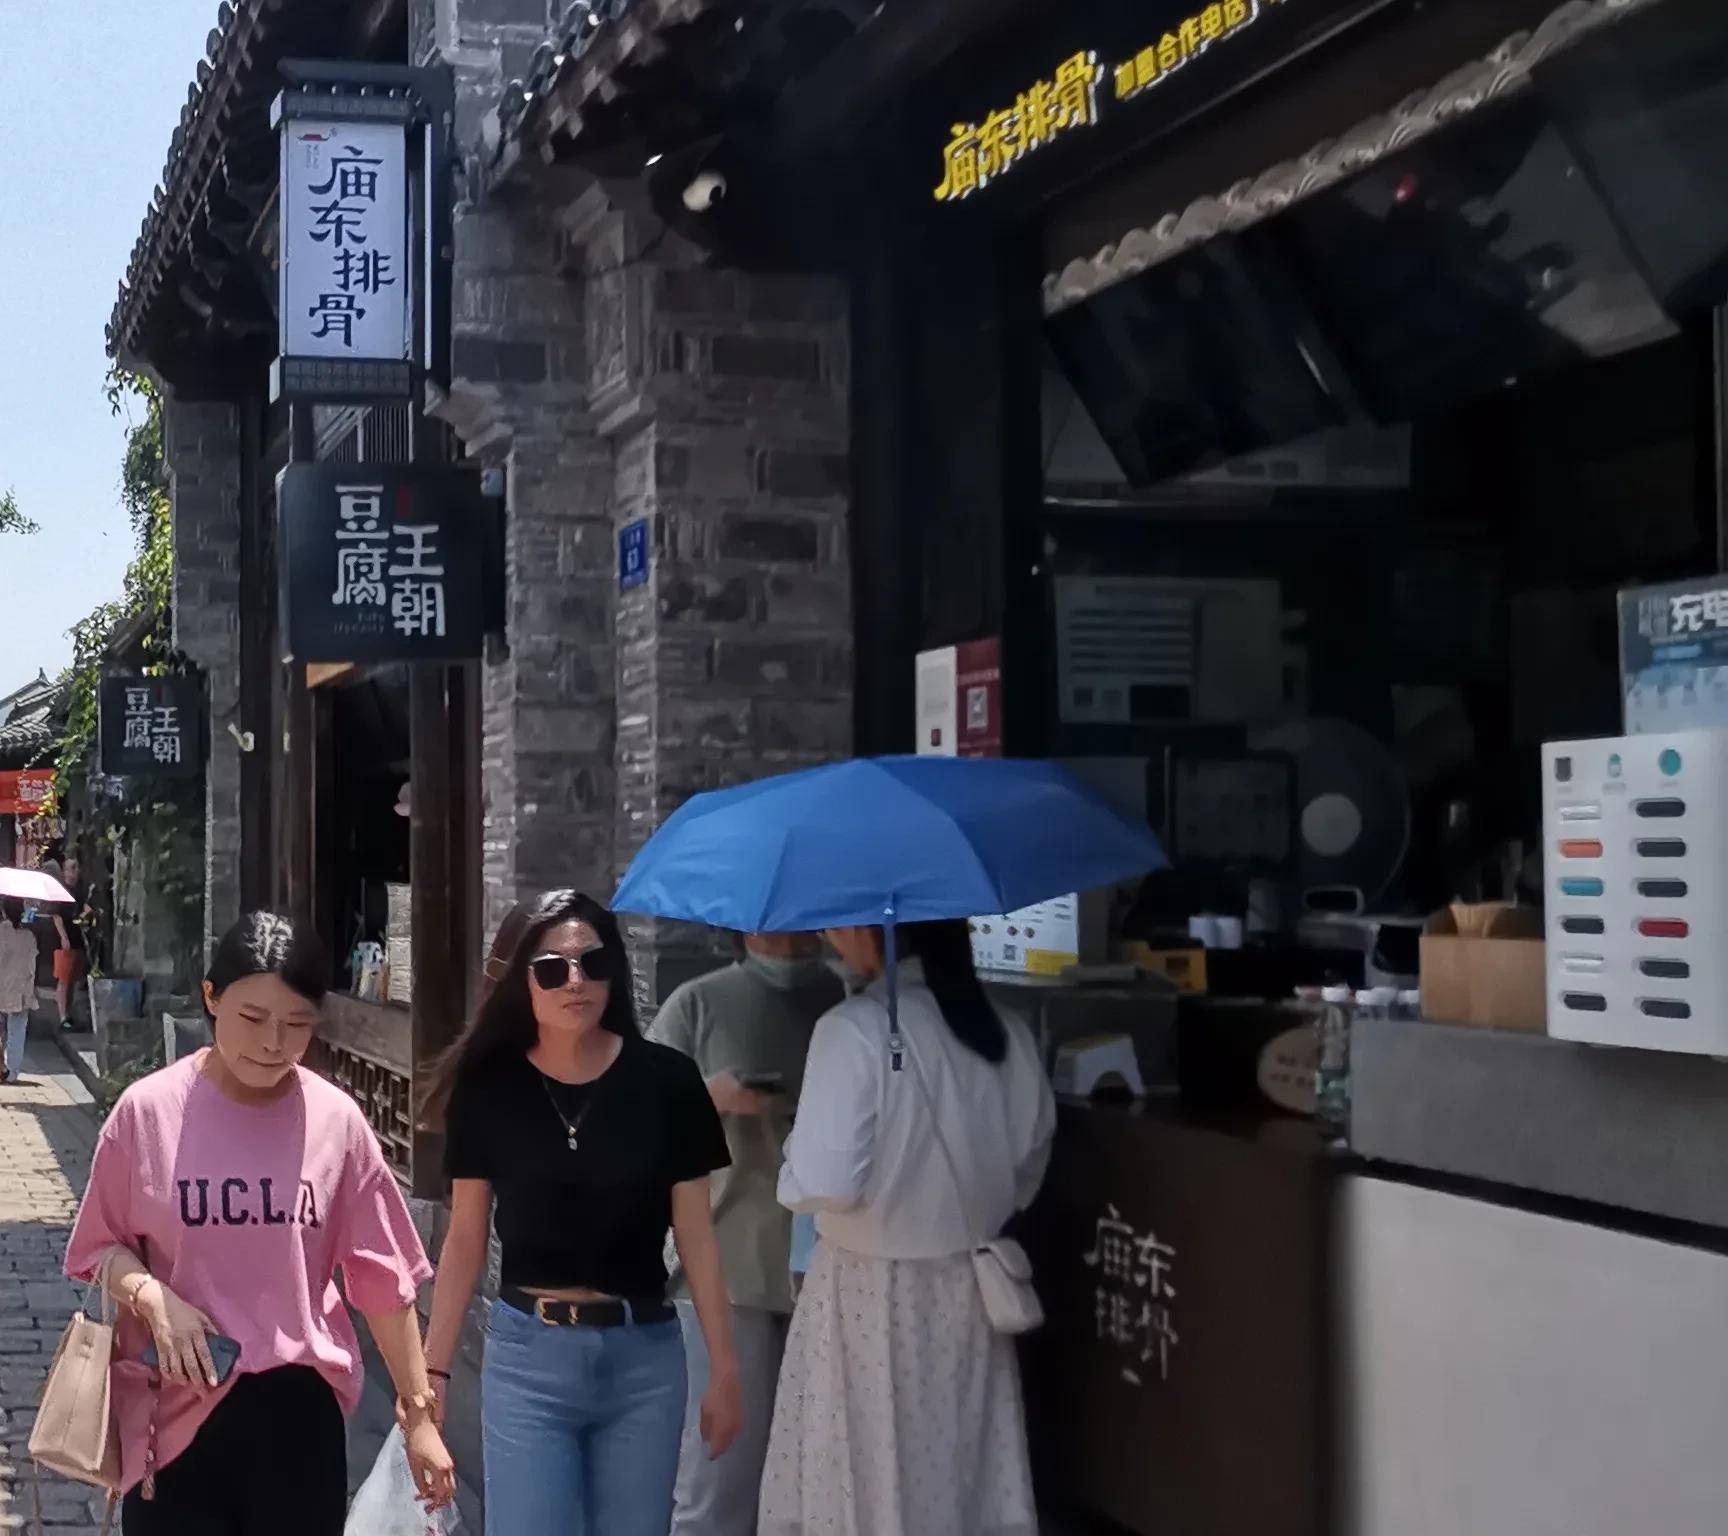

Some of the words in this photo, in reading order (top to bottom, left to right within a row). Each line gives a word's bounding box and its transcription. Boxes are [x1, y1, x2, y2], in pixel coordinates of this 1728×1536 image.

[933, 49, 1098, 202] 庙东排骨
[307, 145, 396, 348] 庙东排骨
[331, 484, 390, 606] 豆腐
[387, 524, 446, 637] 王朝
[123, 687, 153, 748] 豆腐
[151, 706, 181, 763] 王朝
